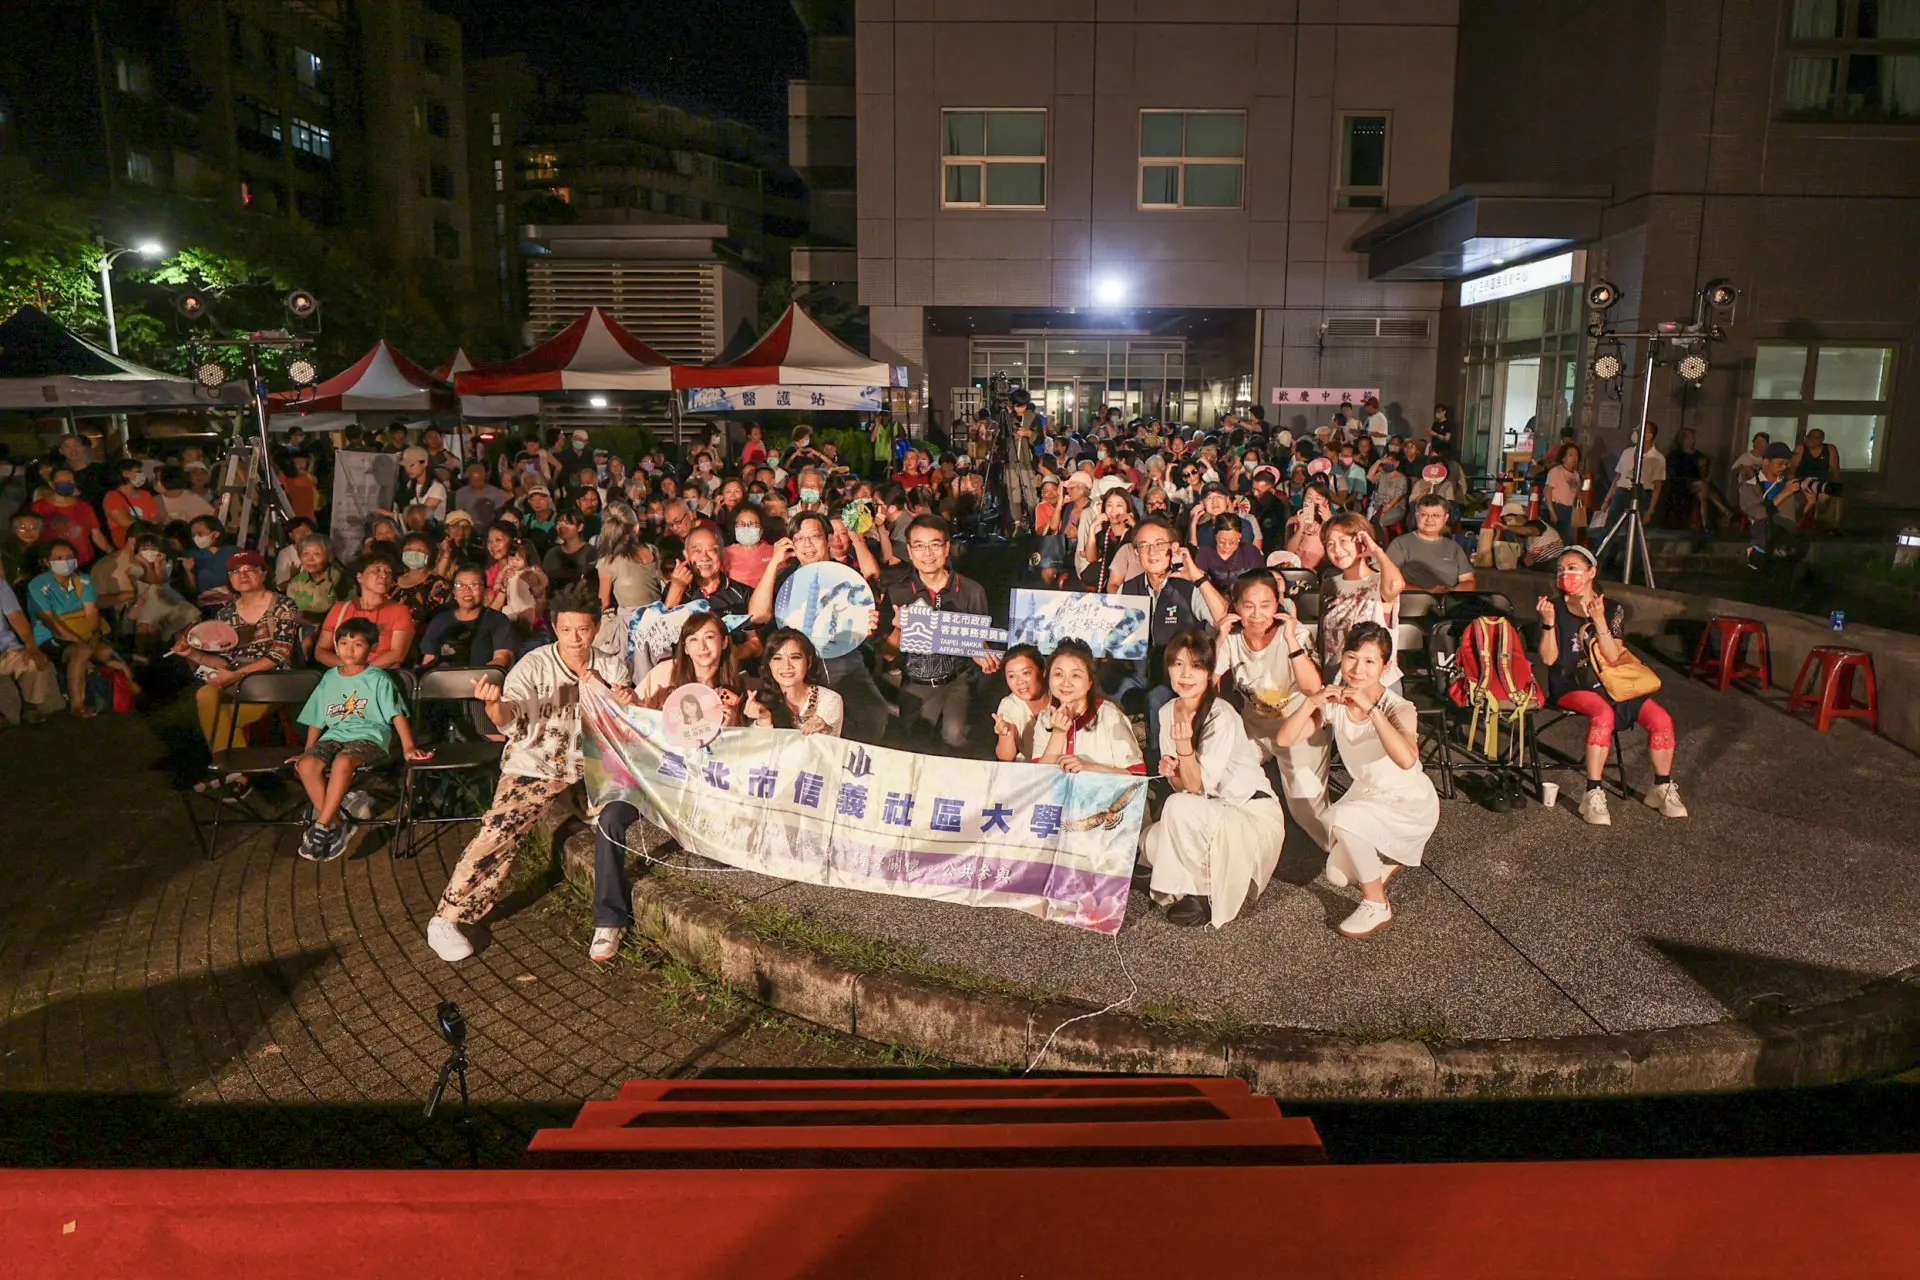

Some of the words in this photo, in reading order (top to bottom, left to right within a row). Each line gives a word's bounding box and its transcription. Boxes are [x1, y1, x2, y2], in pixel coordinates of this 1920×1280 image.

[742, 391, 825, 407] 醫護站
[942, 613, 991, 627] 臺北市政府
[940, 625, 1009, 641] 客家事務委員會
[939, 646, 965, 655] AFFAIRS
[940, 637, 959, 646] TAIPEI
[961, 640, 983, 649] HAKKA
[657, 751, 1063, 839] 臺北市信義社區大學
